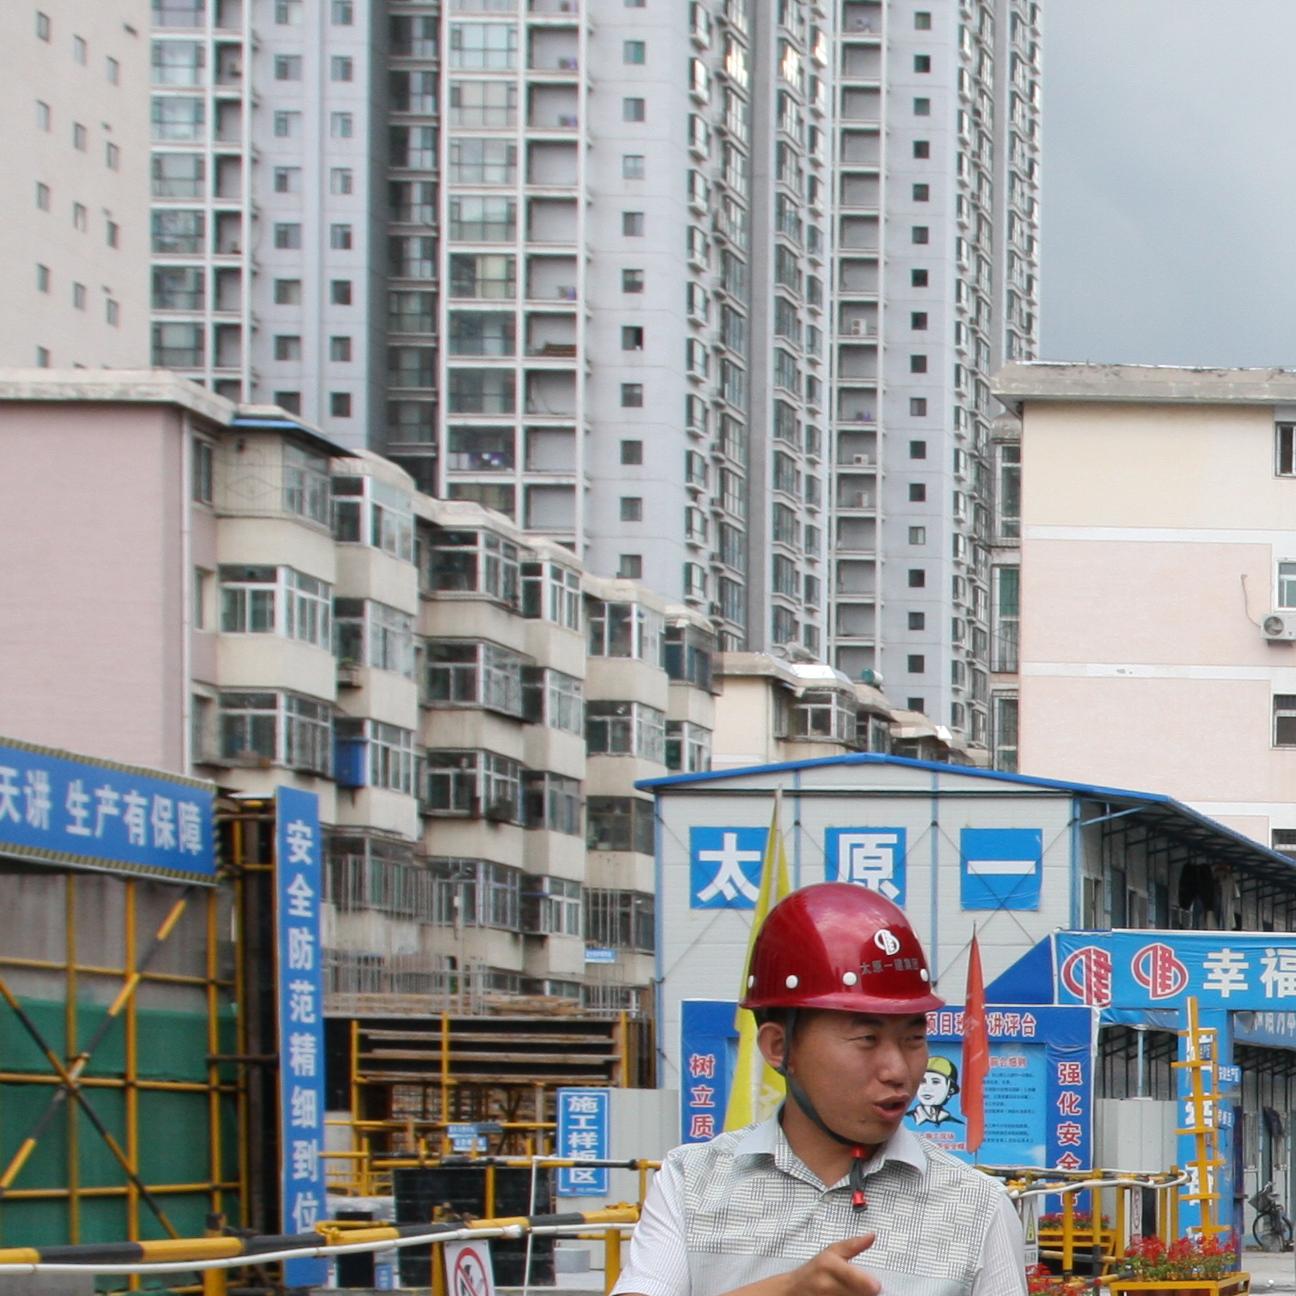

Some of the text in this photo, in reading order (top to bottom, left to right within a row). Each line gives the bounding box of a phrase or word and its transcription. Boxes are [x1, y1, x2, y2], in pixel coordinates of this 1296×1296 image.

[65, 779, 203, 855] 生产有保障
[697, 832, 1036, 902] 太原一
[286, 819, 318, 1235] 安全防范精细到位
[689, 1053, 716, 1138] 树立质
